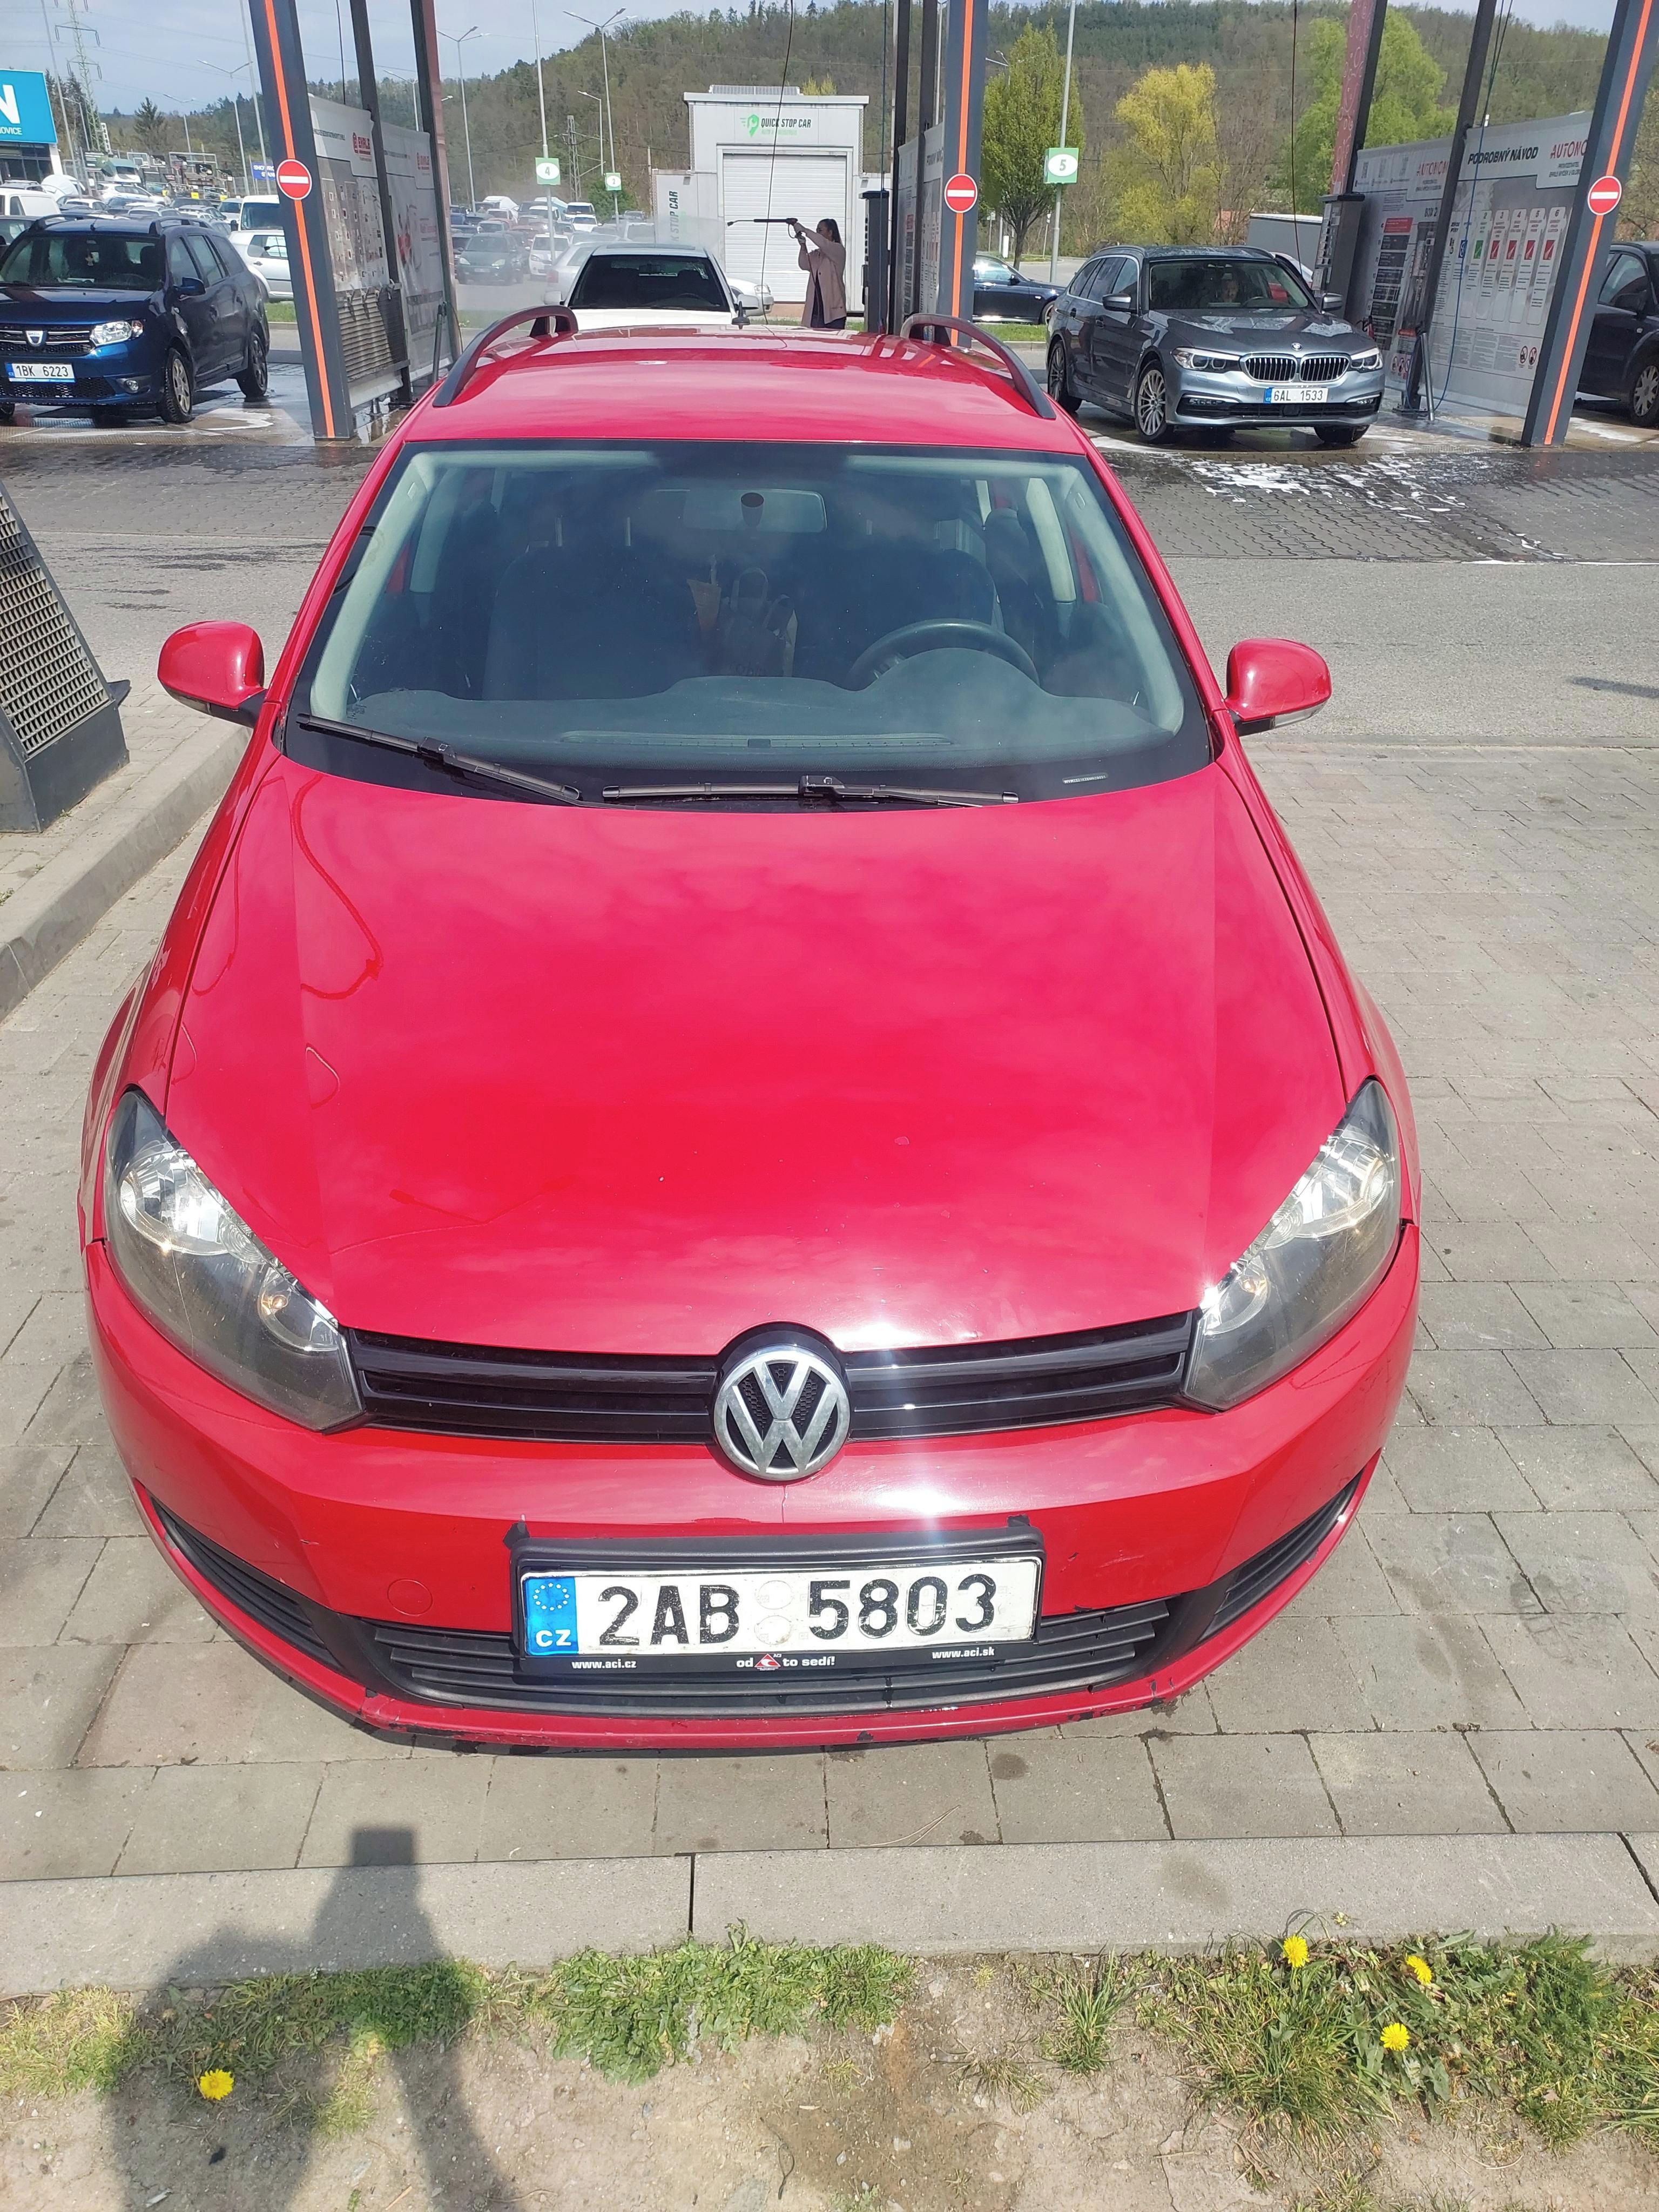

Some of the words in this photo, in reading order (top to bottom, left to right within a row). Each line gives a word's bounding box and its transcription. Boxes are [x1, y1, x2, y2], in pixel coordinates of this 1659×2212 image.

[761, 118, 779, 128] QUICK
[781, 118, 797, 127] STOP
[799, 119, 811, 128] CAR
[0, 126, 23, 135] OVICE
[1467, 147, 1510, 165] PODROBNÝ
[1509, 146, 1539, 161] NÁVOD
[545, 166, 550, 176] 4
[1059, 159, 1066, 171] 5
[669, 191, 678, 210] CAR
[1554, 209, 1560, 217] 6
[16, 365, 36, 376] 1BK
[43, 366, 69, 377] 6223
[1274, 390, 1291, 401] 6AL
[1300, 390, 1323, 401] 1533
[598, 1584, 740, 1646] 2AB
[808, 1573, 996, 1640] 5803
[535, 1629, 571, 1647] CZ
[932, 1647, 995, 1660] www.aci.sk
[571, 1658, 637, 1669] www.aci.cz
[736, 1657, 753, 1668] od
[783, 1657, 798, 1667] to
[801, 1656, 835, 1667] sedí!
